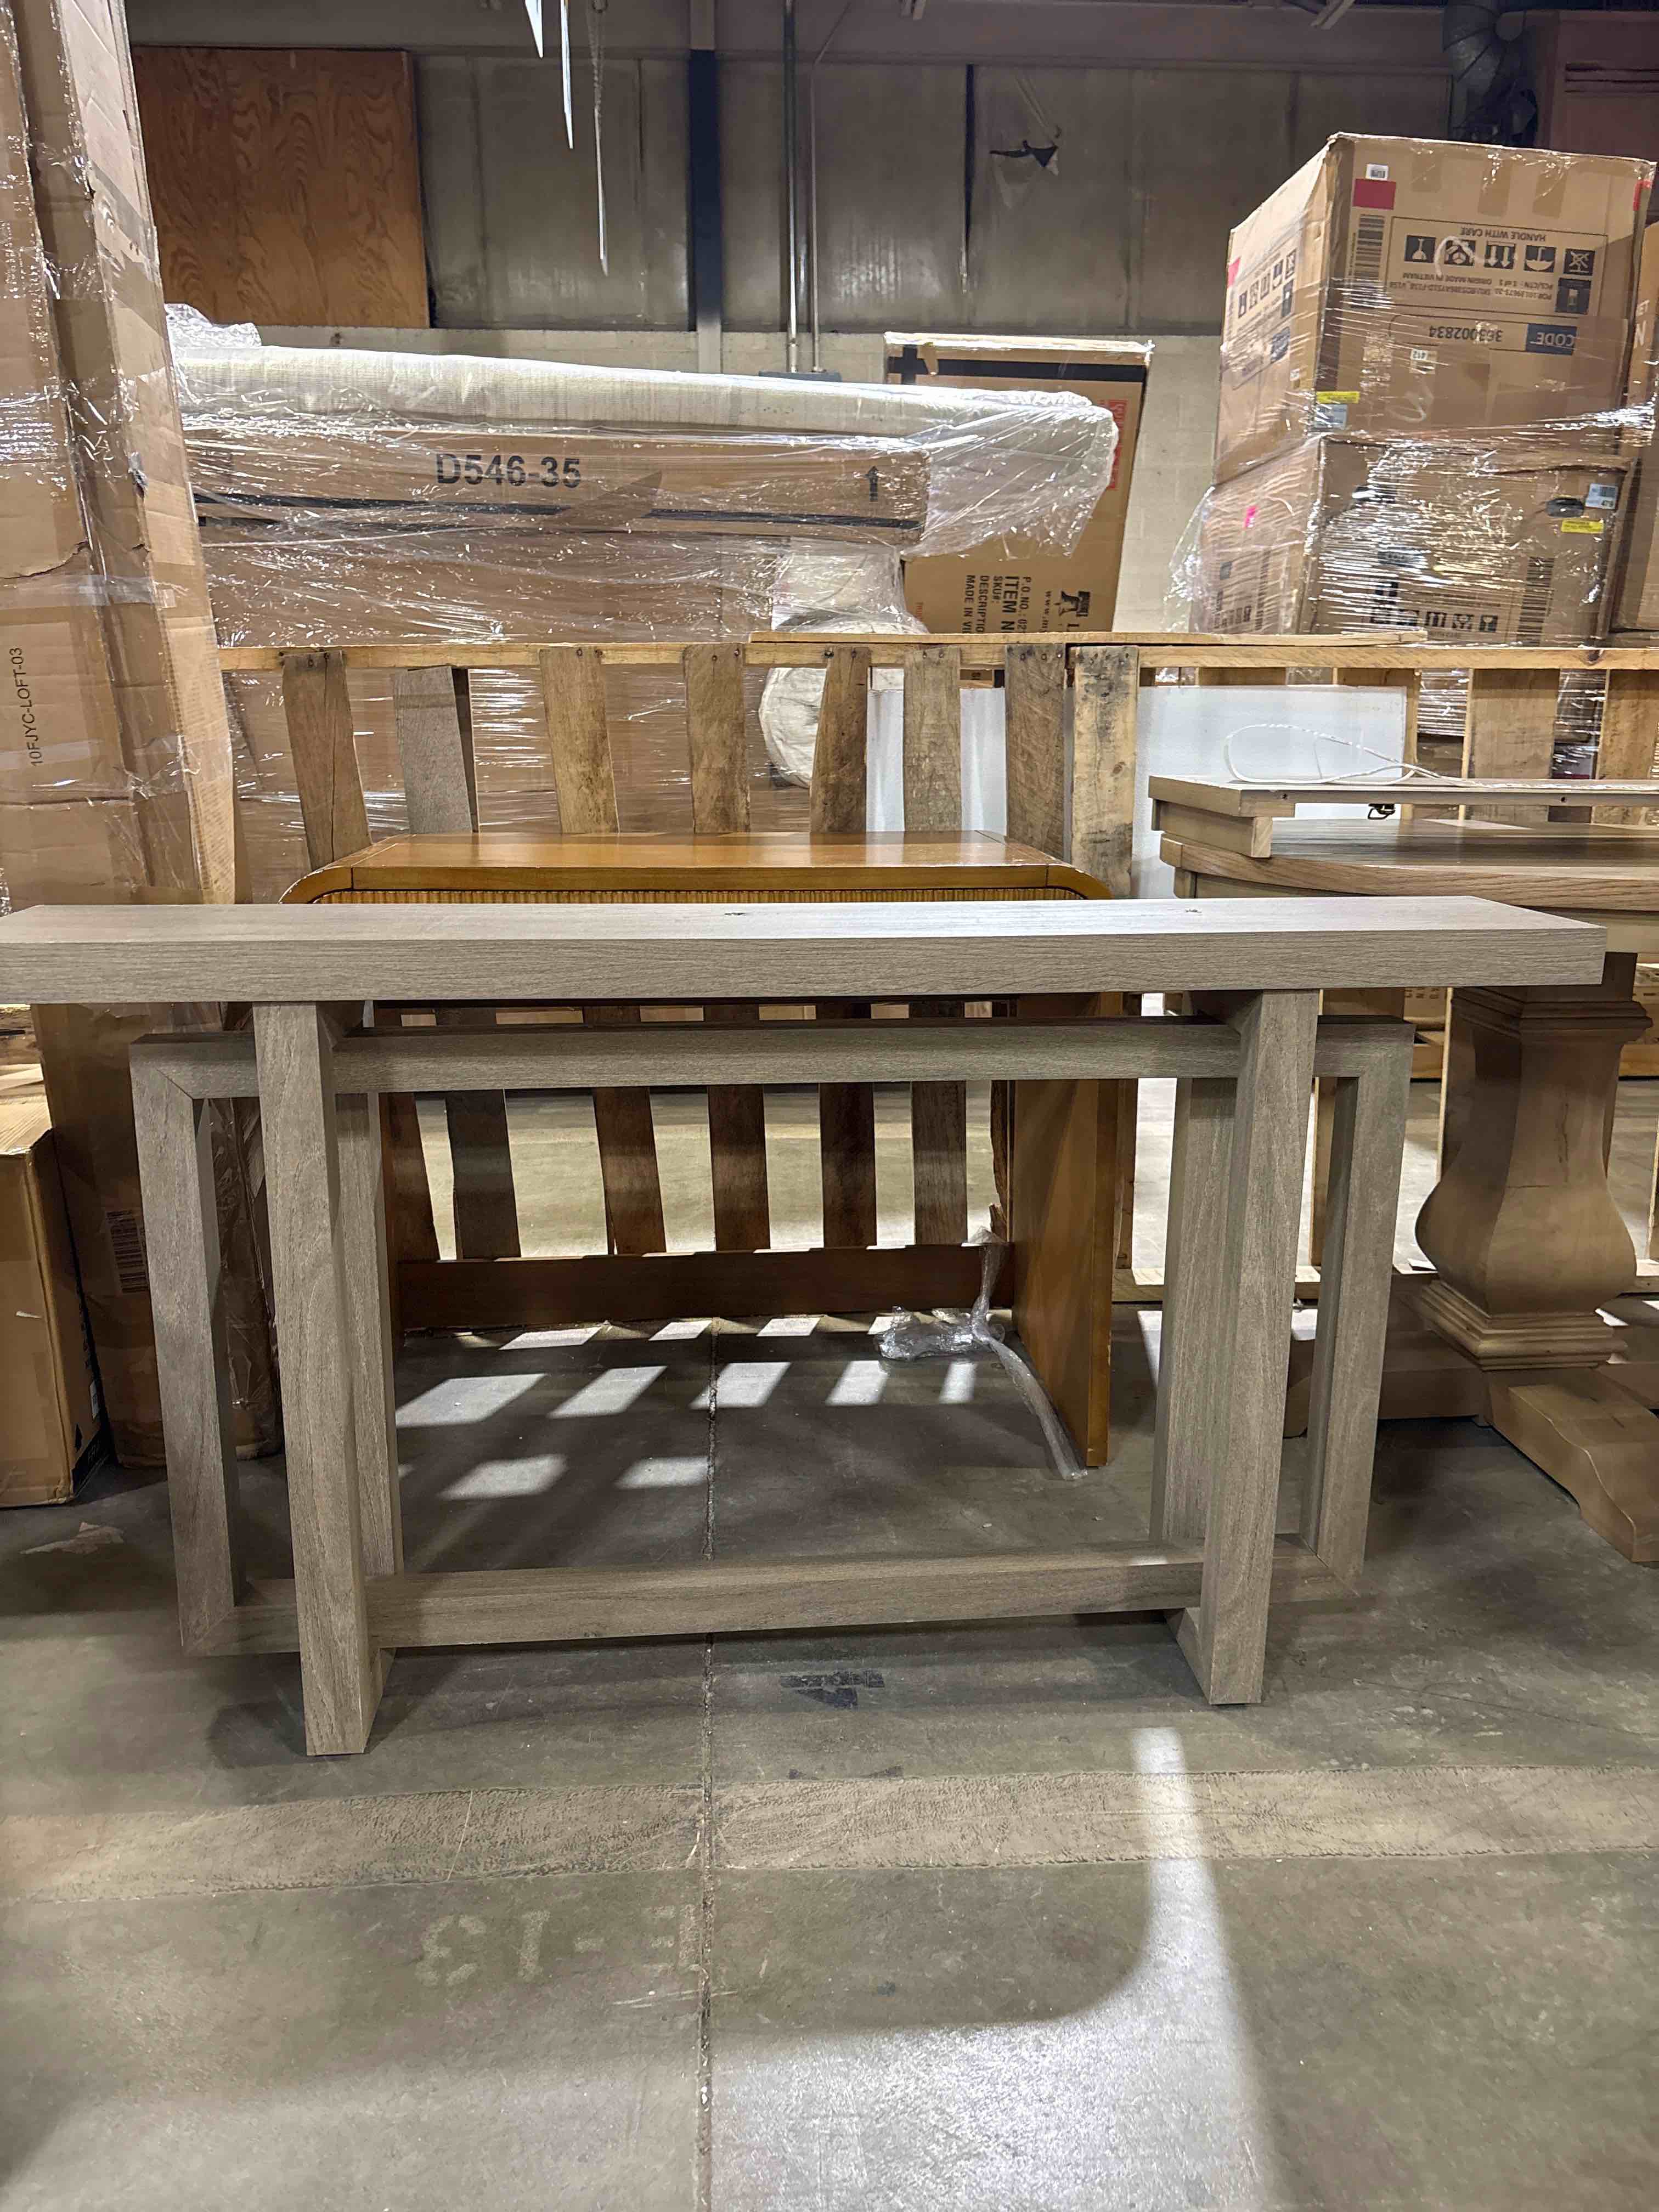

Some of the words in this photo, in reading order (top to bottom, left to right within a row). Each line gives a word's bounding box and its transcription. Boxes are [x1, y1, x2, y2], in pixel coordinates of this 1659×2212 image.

[1460, 227, 1483, 236] CARE
[1485, 229, 1509, 238] WITH
[1511, 232, 1547, 241] HANDLE
[1536, 331, 1575, 347] CODE
[436, 453, 581, 488] D546-35
[964, 575, 976, 603] MADE
[1001, 576, 1020, 613] ITEM
[963, 607, 973, 617] IN
[9, 647, 44, 767] 10FJYC-LOFT-03
